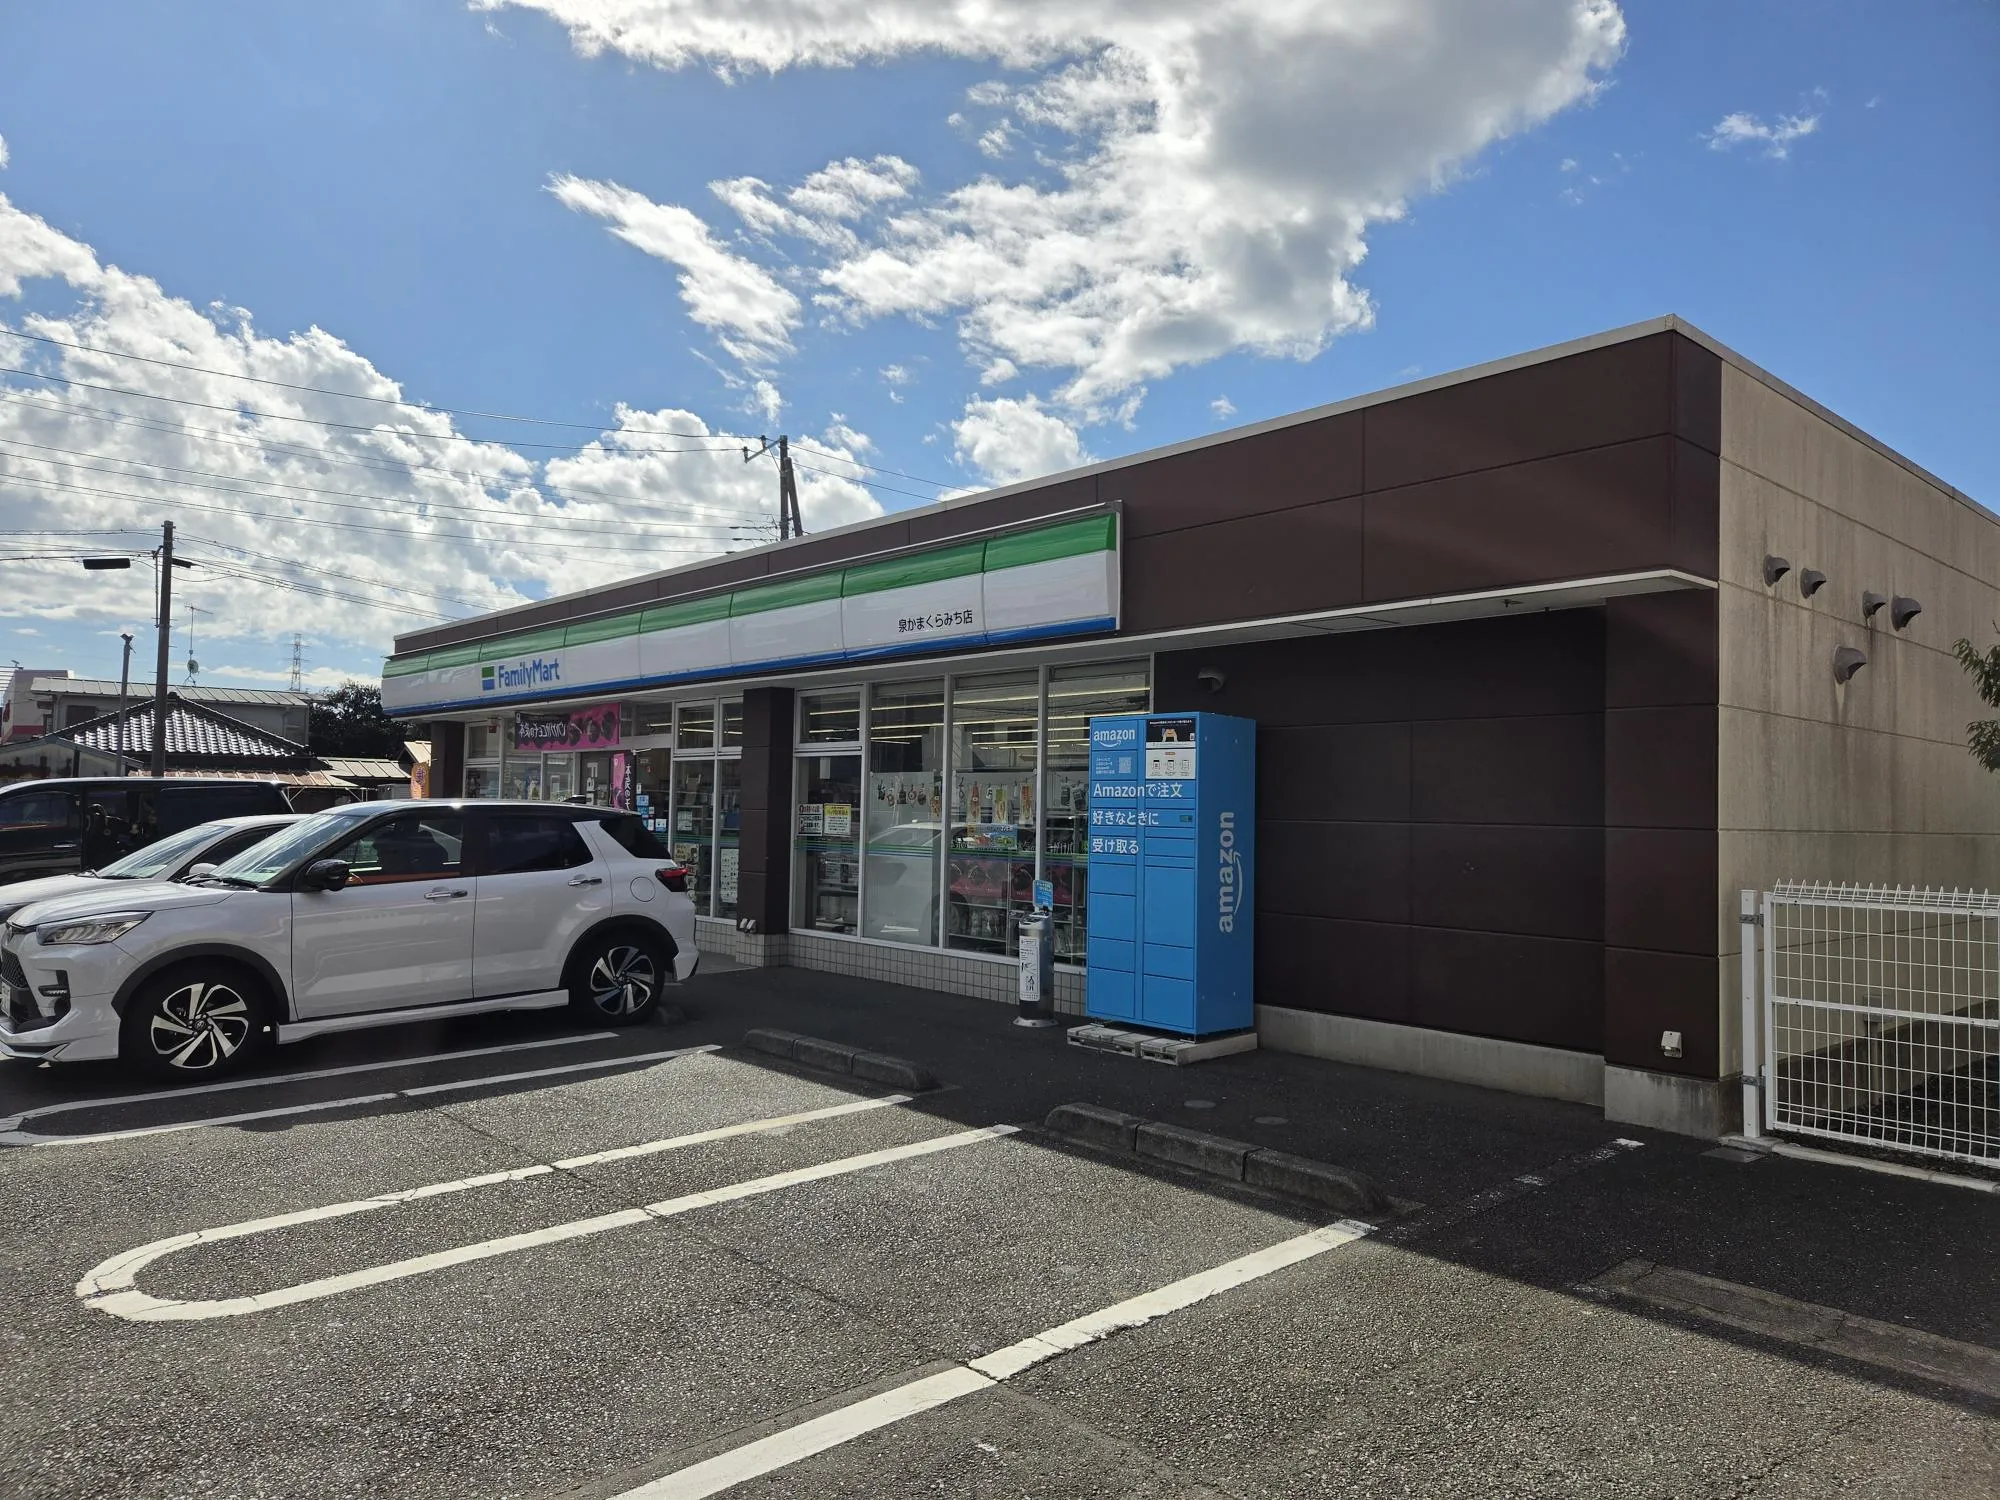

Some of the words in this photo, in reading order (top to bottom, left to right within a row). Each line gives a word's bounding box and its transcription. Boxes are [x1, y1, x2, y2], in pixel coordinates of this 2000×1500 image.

[898, 609, 973, 632] 泉かまくらみち店
[498, 658, 560, 690] FamilyMart
[1093, 728, 1136, 742] amazon
[1093, 782, 1183, 798] Amazonで注文
[1092, 810, 1159, 826] 好きなときに
[1092, 838, 1139, 854] 受け取る
[1219, 812, 1236, 933] amazon
